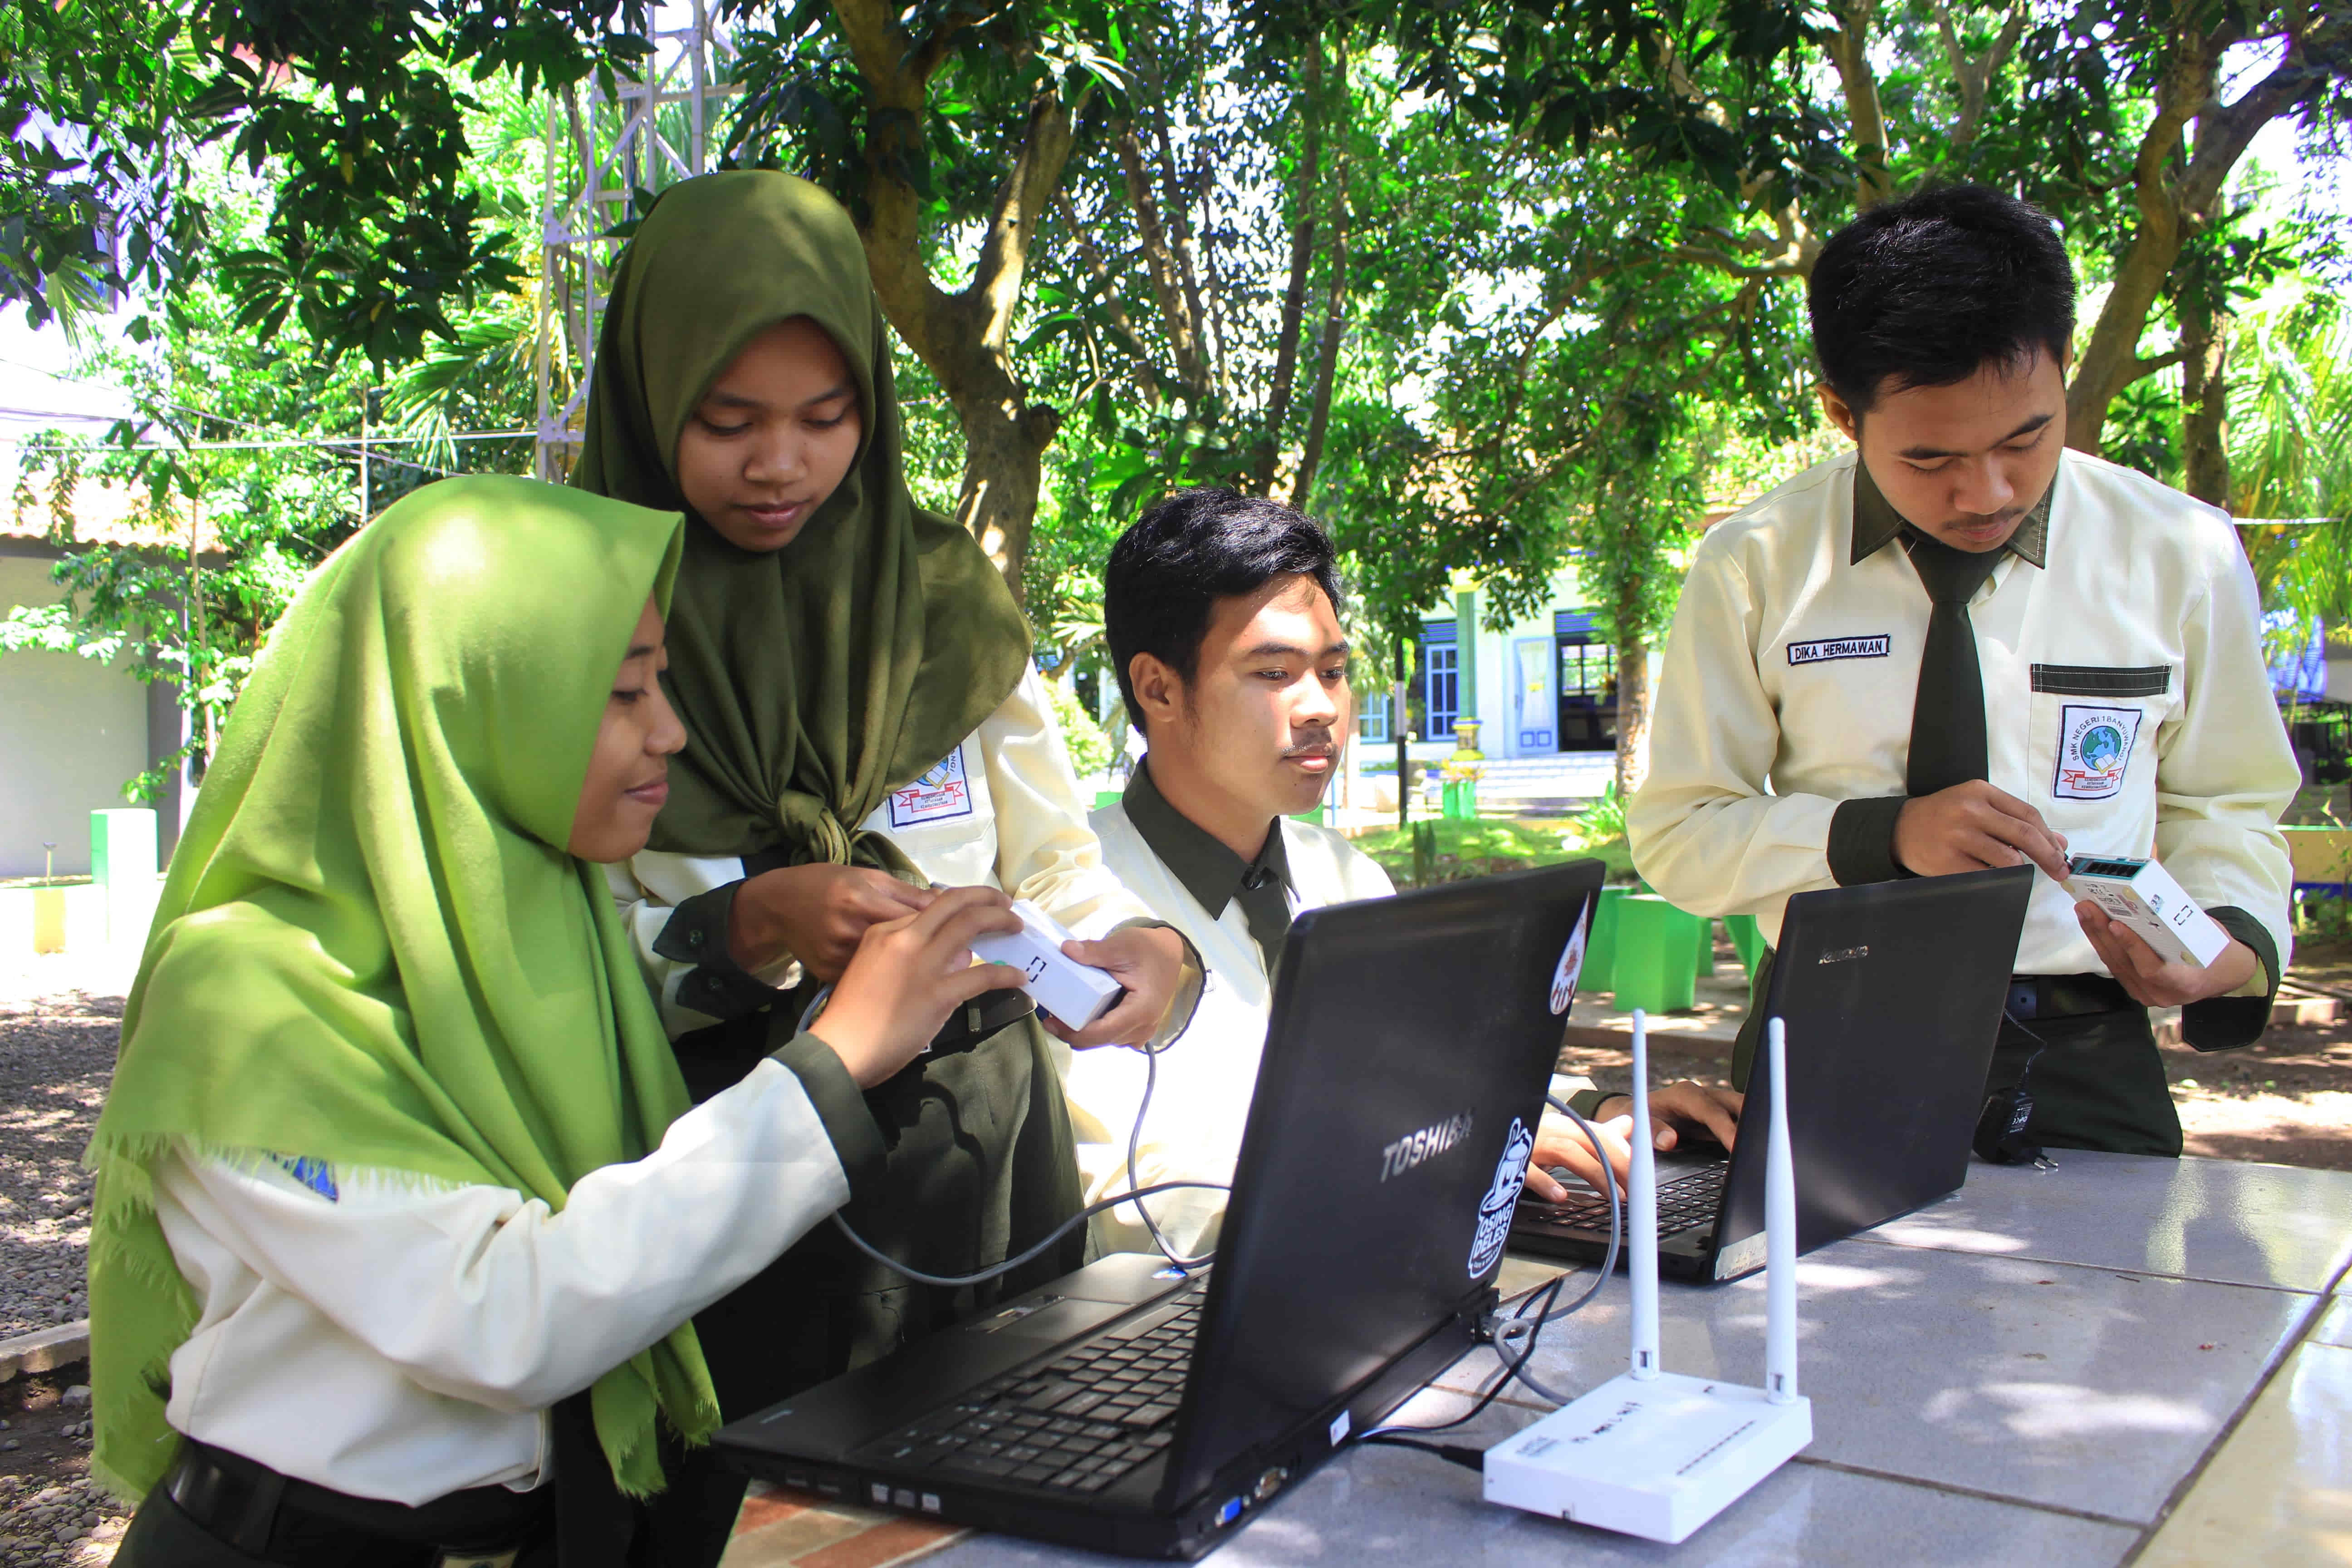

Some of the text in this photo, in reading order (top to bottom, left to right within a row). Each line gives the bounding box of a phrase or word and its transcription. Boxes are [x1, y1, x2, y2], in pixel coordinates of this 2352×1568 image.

[1795, 640, 1882, 660] DIKA HERMAWAN
[2073, 716, 2099, 740] NEGERI
[2070, 743, 2079, 761] SMK
[1381, 1107, 1473, 1183] TOSHIBA
[1474, 1222, 1507, 1259] DELES
